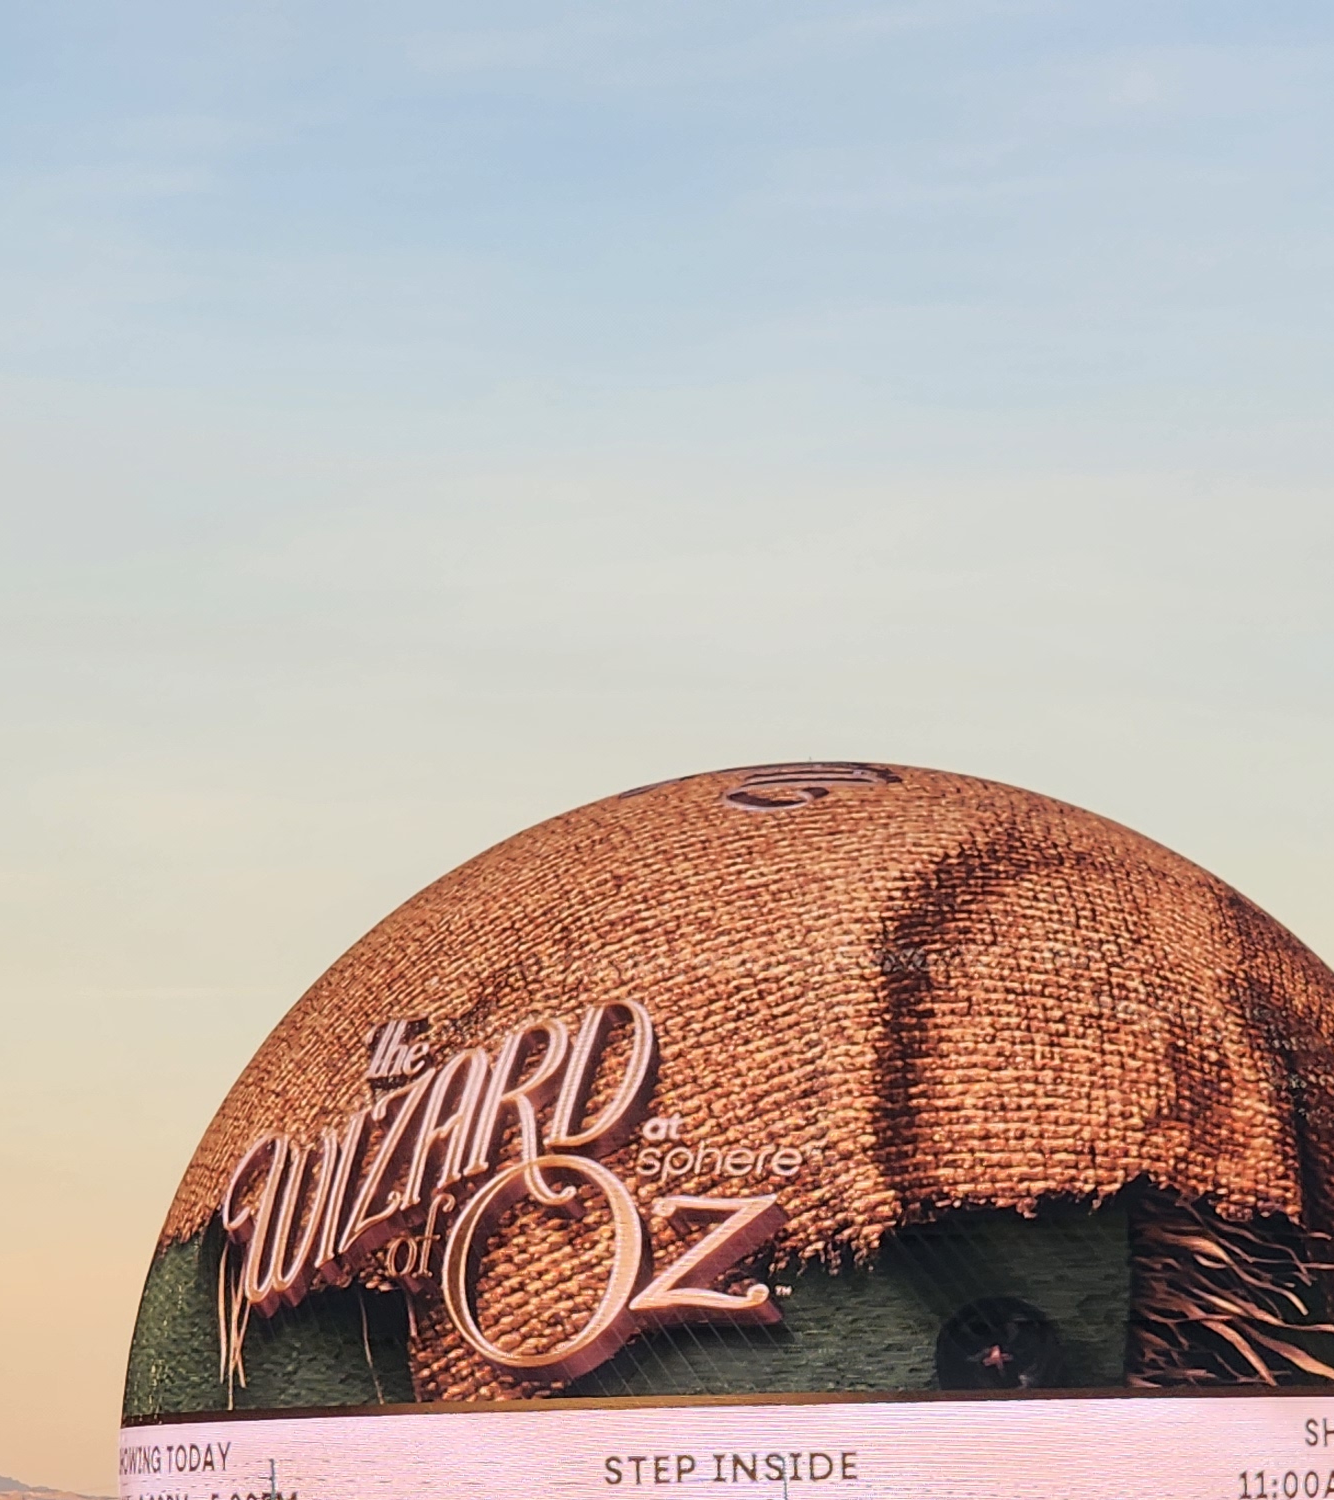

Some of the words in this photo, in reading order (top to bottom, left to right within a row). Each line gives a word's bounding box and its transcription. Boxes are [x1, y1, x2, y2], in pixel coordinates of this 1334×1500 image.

[641, 1117, 681, 1142] at
[223, 1000, 655, 1303] WIZARD
[636, 1145, 804, 1181] sphere
[385, 1193, 457, 1279] of
[166, 1441, 231, 1472] TODAY
[604, 1454, 696, 1486] STEP
[713, 1451, 859, 1483] INSIDE
